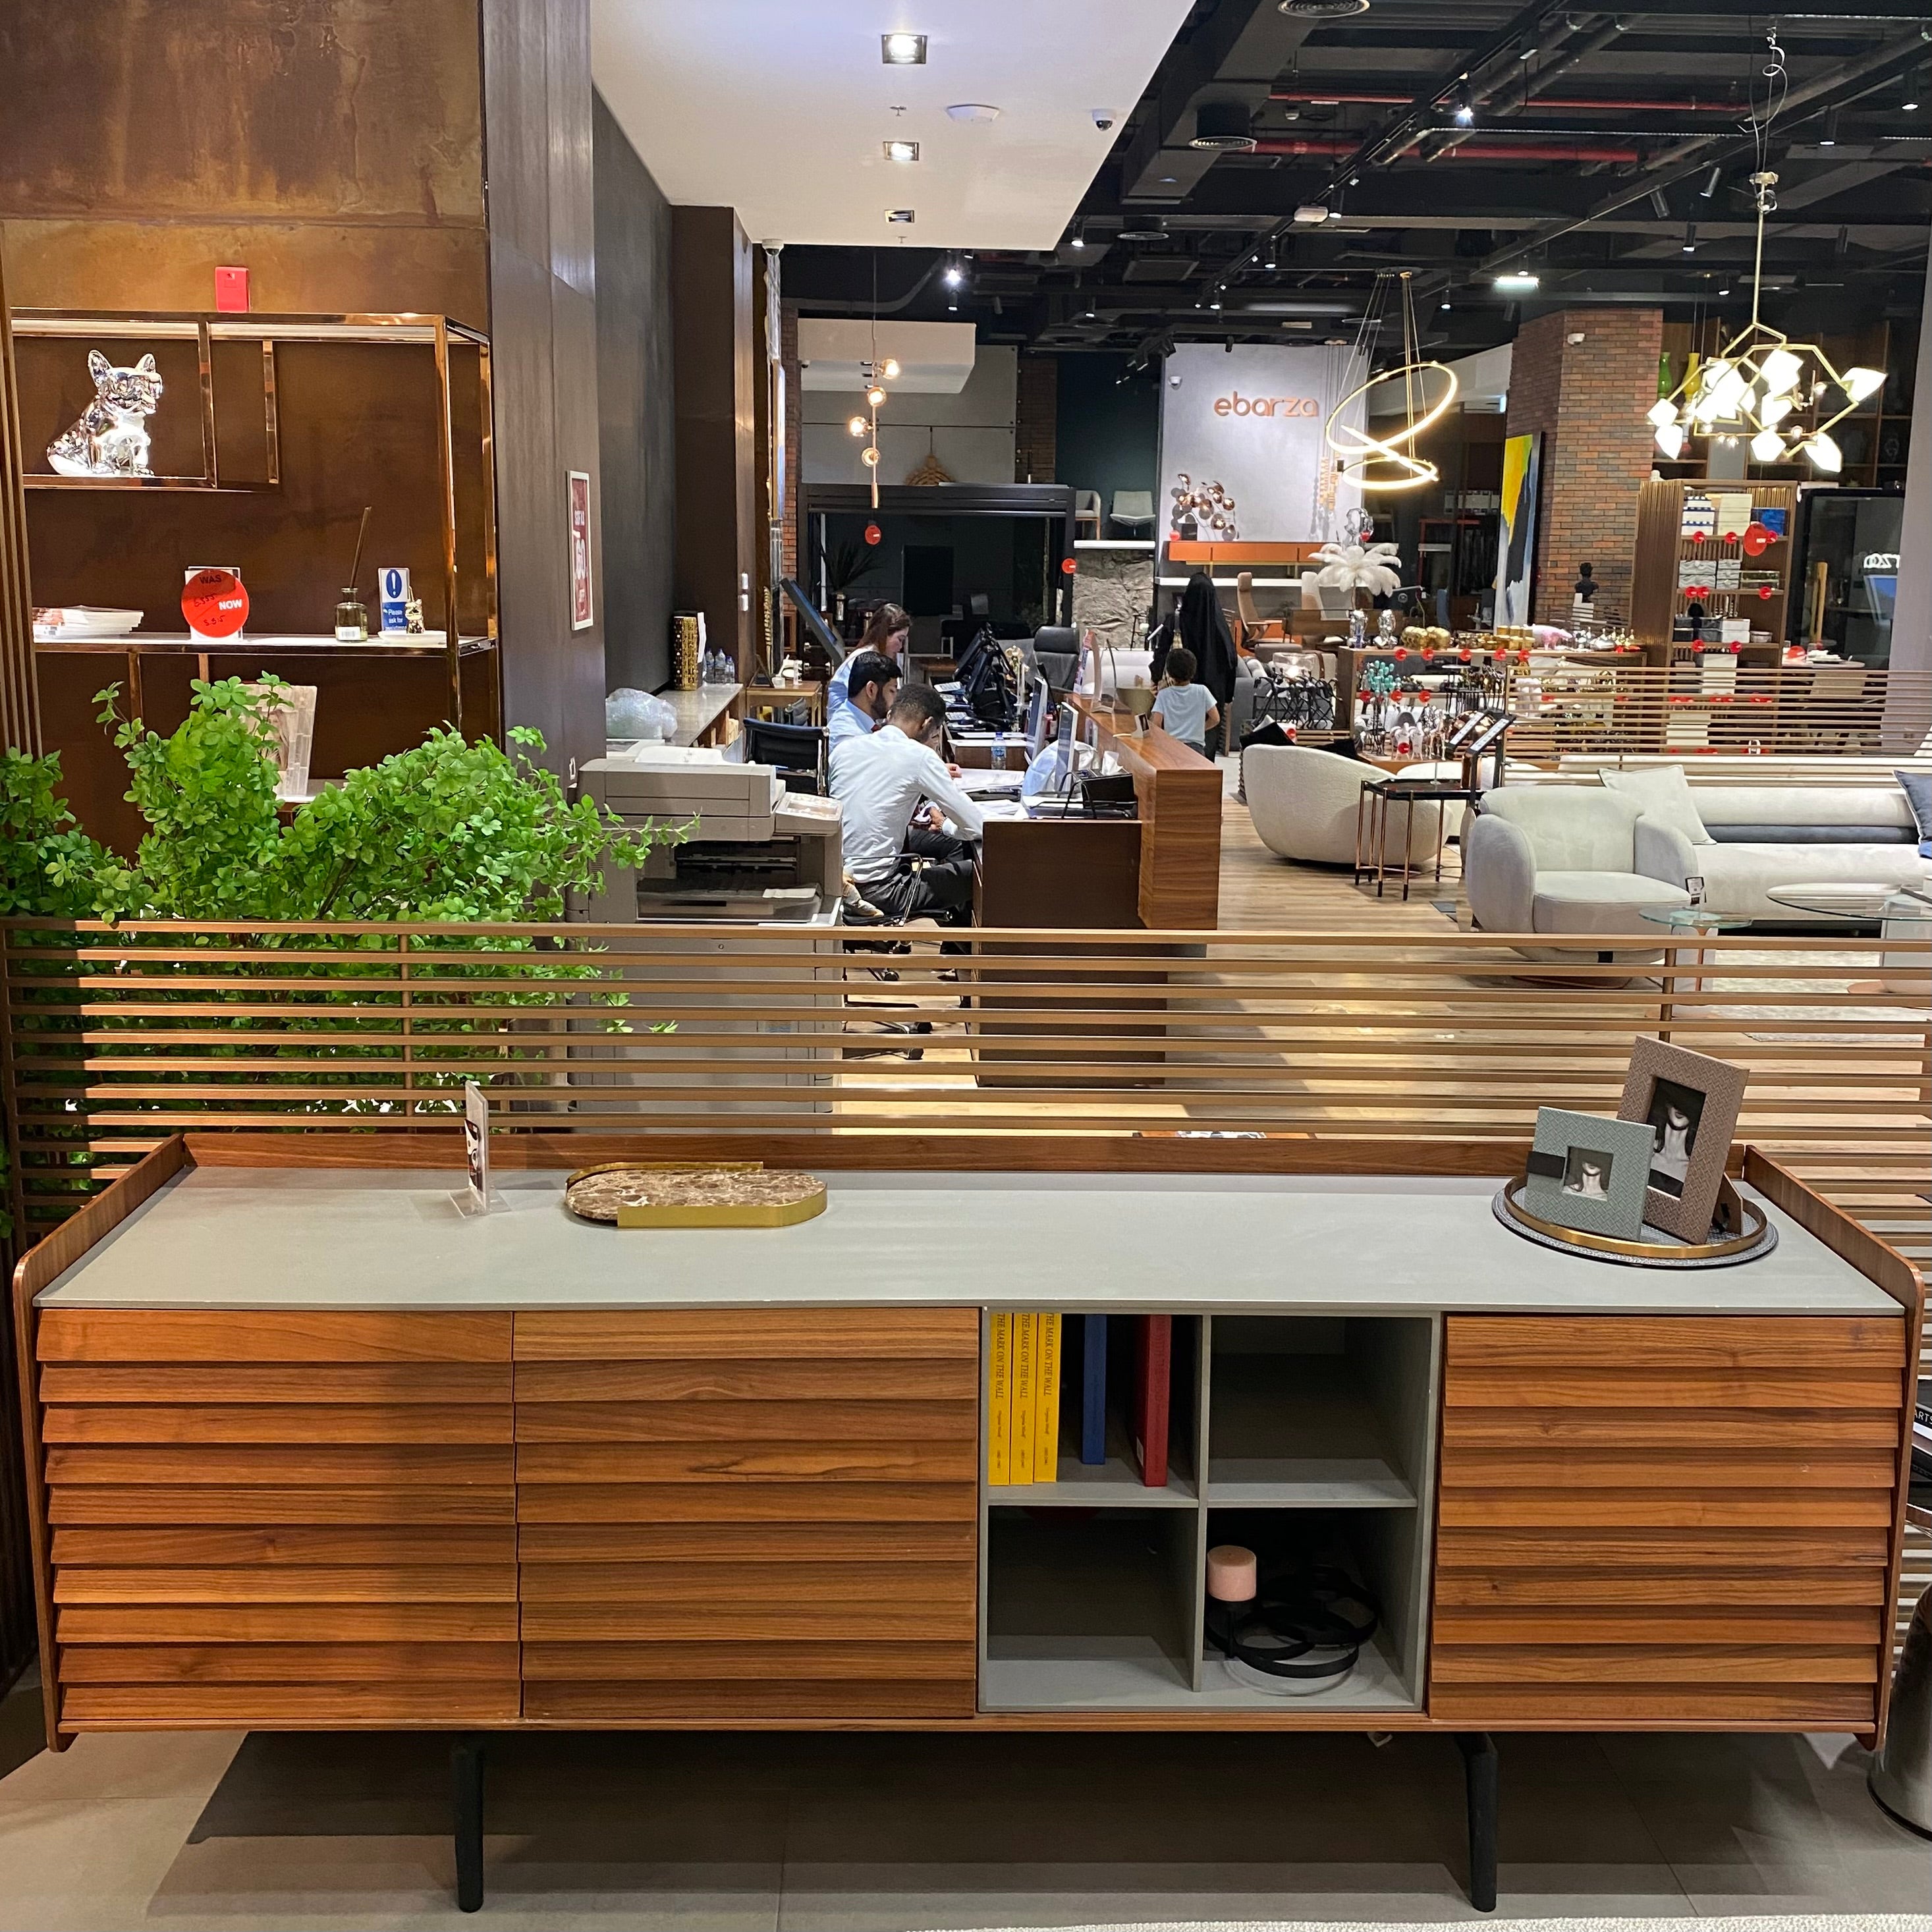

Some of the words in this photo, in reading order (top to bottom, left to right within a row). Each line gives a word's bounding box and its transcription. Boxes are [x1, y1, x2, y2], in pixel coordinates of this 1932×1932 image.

[1214, 391, 1319, 416] ebarza
[200, 574, 221, 584] WAS
[219, 599, 242, 611] NOW
[1022, 1313, 1030, 1329] THE
[997, 1351, 1005, 1362] ON
[1021, 1351, 1029, 1363] ON
[1045, 1349, 1053, 1361] ON
[996, 1364, 1005, 1379] THE
[1044, 1362, 1053, 1377] THE
[995, 1379, 1004, 1399] WALL
[1020, 1380, 1028, 1398] WALL
[1043, 1377, 1052, 1396] WALL
